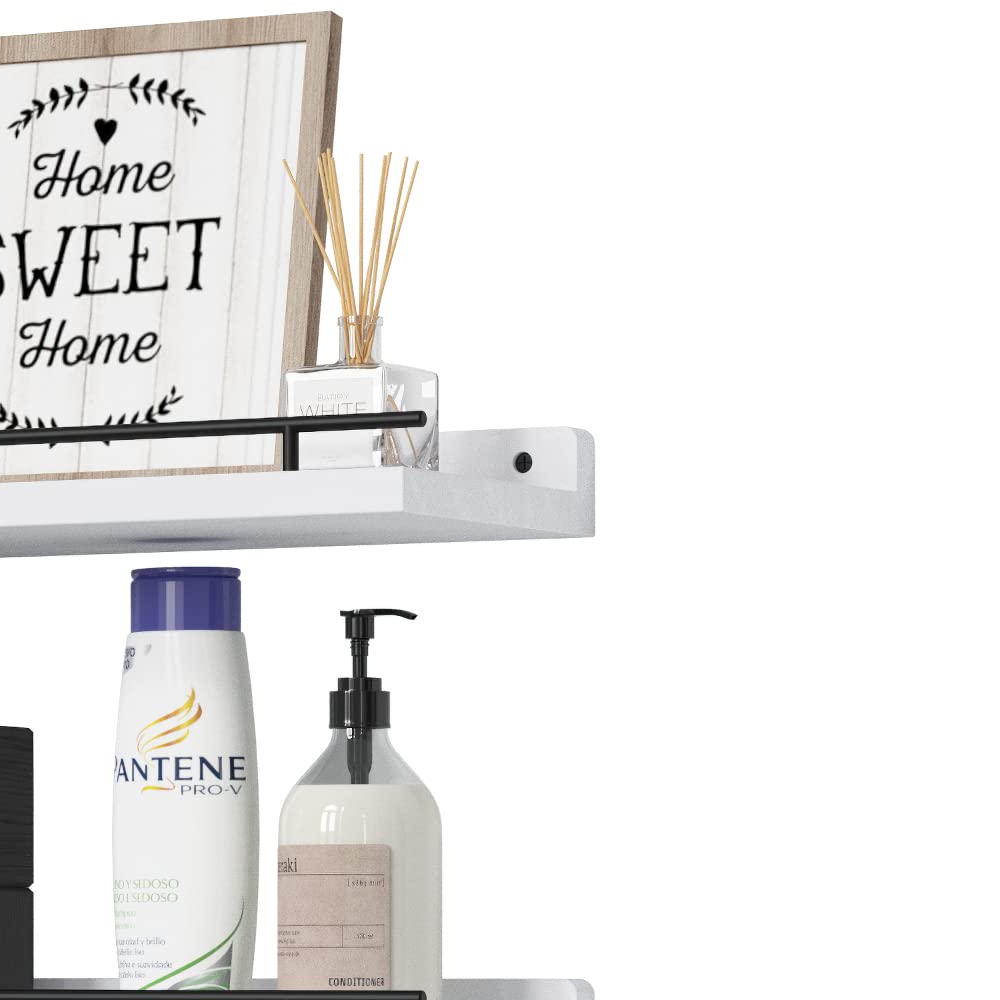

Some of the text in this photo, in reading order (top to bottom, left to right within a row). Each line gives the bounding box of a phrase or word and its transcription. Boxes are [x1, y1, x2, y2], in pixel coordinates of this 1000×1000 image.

[33, 149, 175, 199] Home
[19, 318, 162, 368] Home
[180, 784, 243, 796] PRO-V
[328, 977, 385, 987] CONDITIONER
